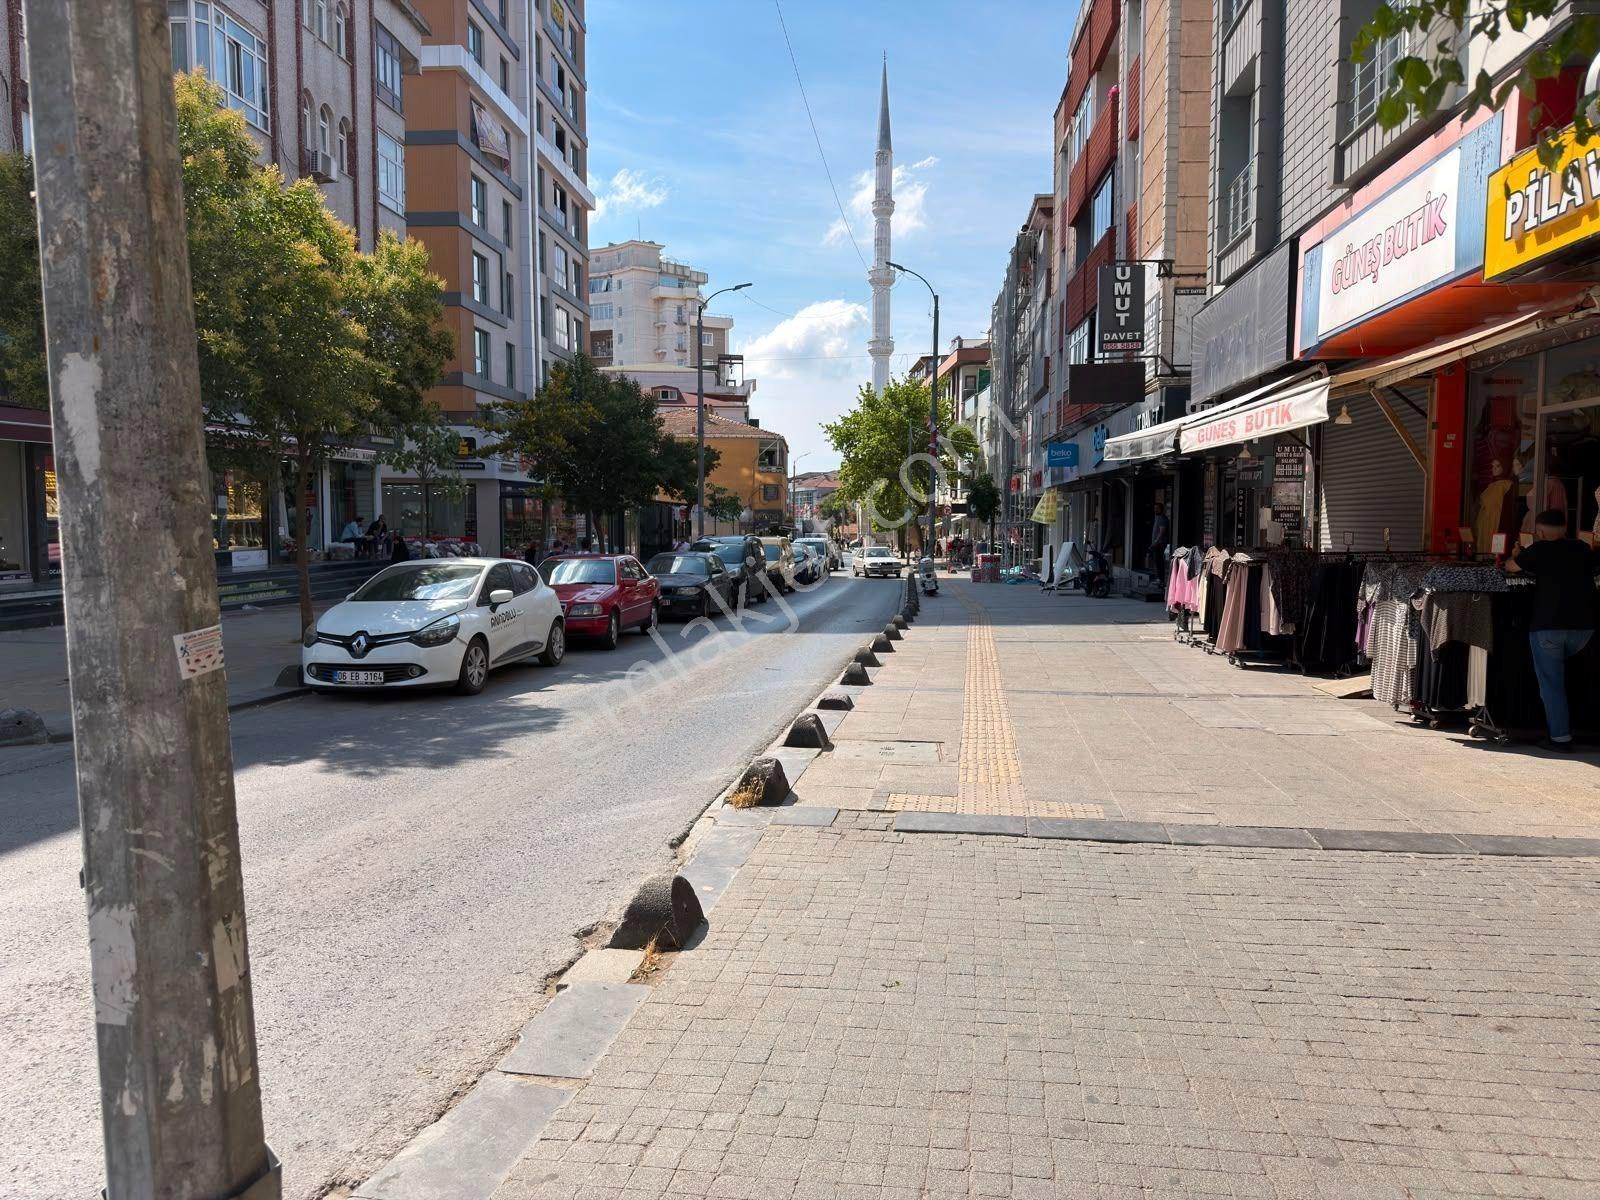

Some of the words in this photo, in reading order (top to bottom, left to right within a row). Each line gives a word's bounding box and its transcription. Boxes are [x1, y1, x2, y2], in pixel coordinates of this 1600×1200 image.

[1332, 233, 1382, 294] GÜNEŞ
[1382, 191, 1447, 267] BUTİK
[1114, 266, 1131, 326] UMUT
[1104, 332, 1141, 341] DAVET
[1244, 401, 1292, 433] BUTİK
[1051, 449, 1072, 457] beko
[337, 672, 347, 680] 06
[350, 672, 360, 681] EB
[363, 672, 383, 681] 3164
